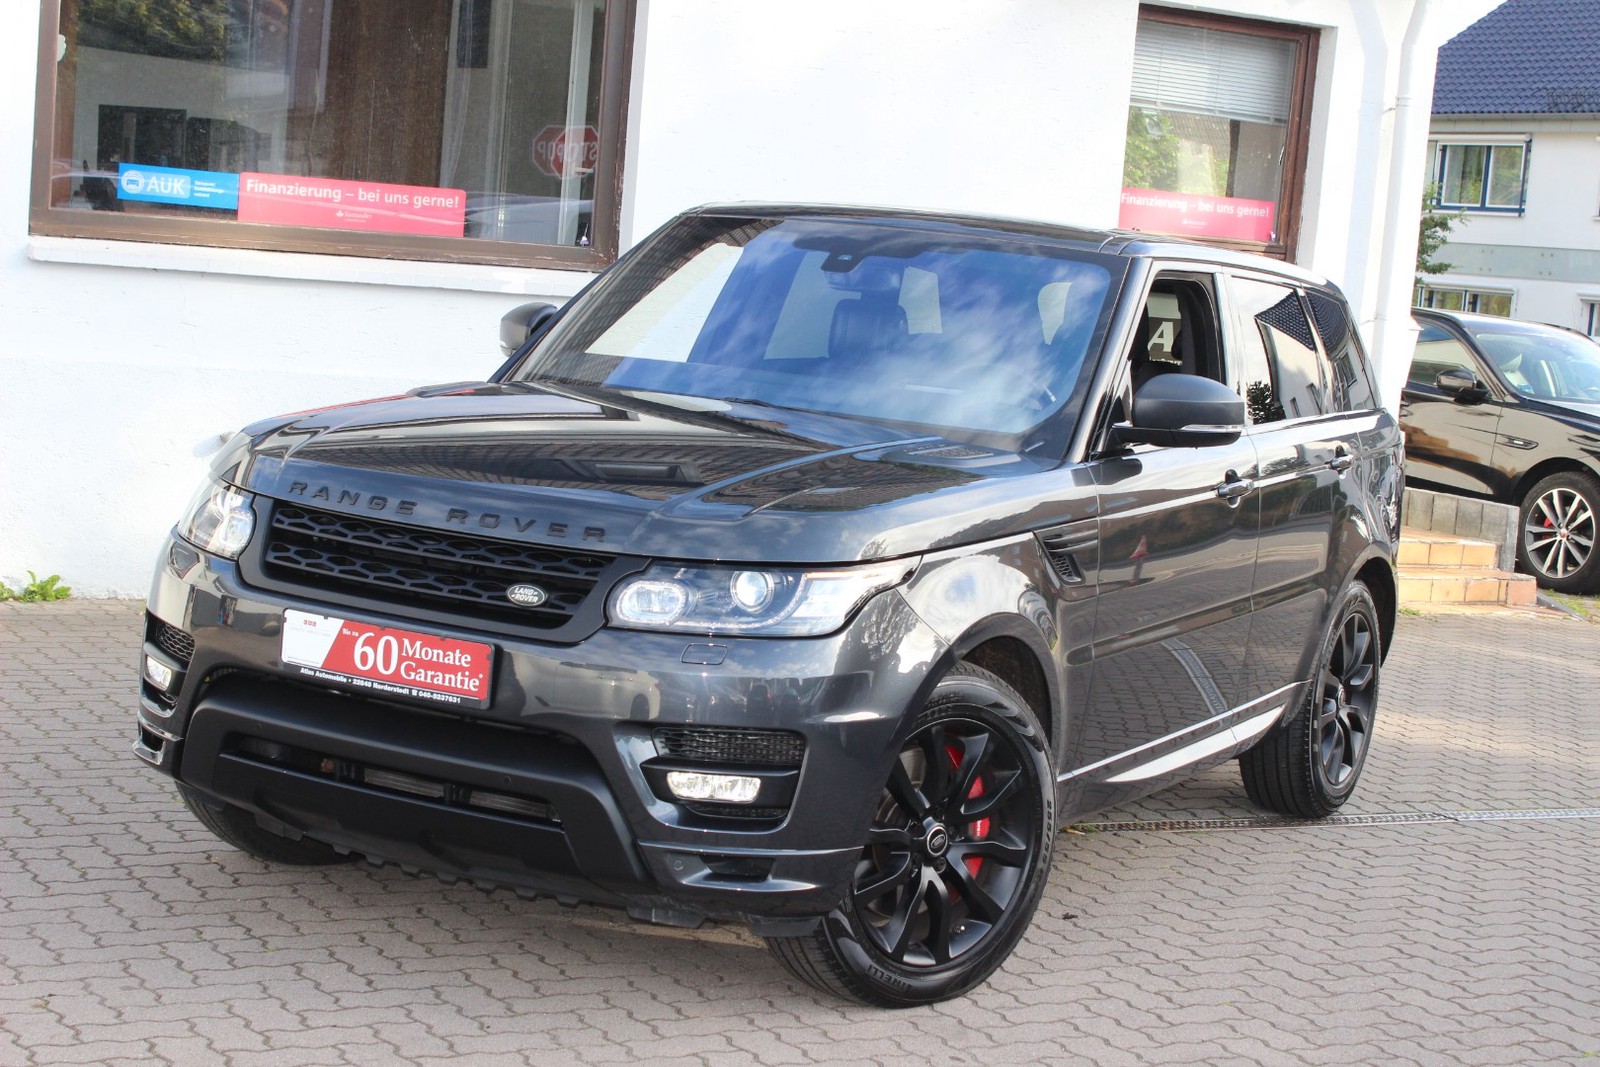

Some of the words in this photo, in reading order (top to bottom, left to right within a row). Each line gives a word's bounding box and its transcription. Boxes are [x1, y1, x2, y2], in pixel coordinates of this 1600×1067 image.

[146, 175, 186, 196] AÜK
[246, 178, 342, 202] Finanzierung
[358, 188, 380, 203] bei
[384, 193, 409, 205] uns
[413, 194, 459, 209] gerne!
[1120, 192, 1188, 213] Finanzierung
[1197, 200, 1214, 213] bei
[1217, 204, 1234, 214] uns
[1236, 206, 1270, 218] gerne!
[288, 481, 418, 516] RANGE
[445, 508, 606, 543] ROVER
[514, 586, 534, 596] LAND
[514, 593, 539, 603] ROVER
[353, 631, 399, 676] 60
[401, 638, 472, 668] Monate
[300, 667, 315, 676] Atlas
[315, 670, 348, 683] Automobile
[372, 682, 410, 695] Norderstedt
